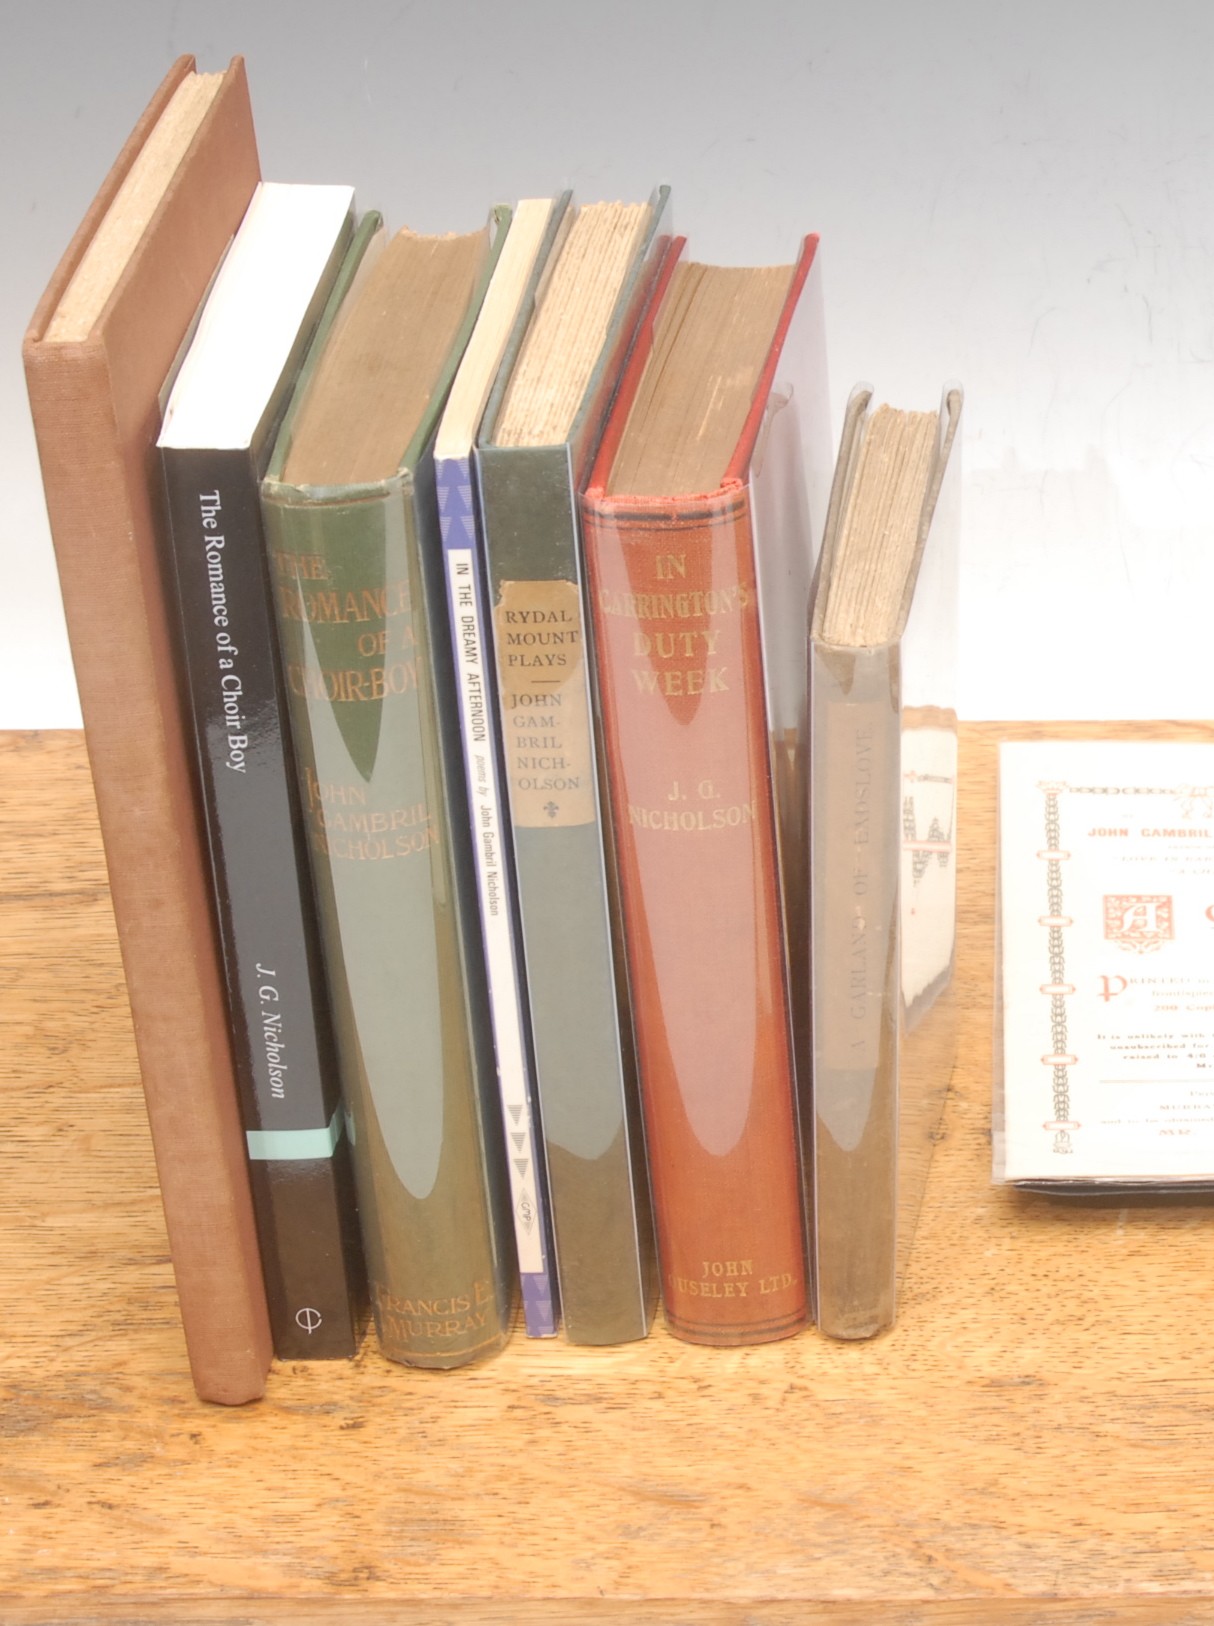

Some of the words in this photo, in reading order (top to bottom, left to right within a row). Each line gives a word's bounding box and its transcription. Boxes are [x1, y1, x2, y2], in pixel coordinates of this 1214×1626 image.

[199, 490, 222, 529] The
[273, 551, 328, 580] THE
[456, 563, 468, 575] IN
[655, 554, 686, 580] IN
[204, 535, 230, 627] Romance
[279, 580, 411, 624] ROMANCE
[458, 585, 472, 607] THE
[506, 610, 572, 624] RYDAL
[216, 632, 238, 655] of
[357, 631, 389, 657] OF
[461, 615, 478, 665] DREAMY
[507, 630, 578, 645] MOUNT
[633, 630, 721, 659] DUTY
[219, 657, 234, 669] a
[508, 654, 567, 666] PLAYS
[631, 667, 730, 696] WEEK
[221, 674, 246, 729] Choir
[467, 673, 486, 742] AFTERNOON
[511, 694, 562, 709] JOHN
[513, 716, 560, 728] GAM-
[226, 734, 248, 774] Boy
[517, 736, 562, 749] BRIL
[475, 755, 487, 784] poems
[517, 757, 571, 769] NICH-
[305, 767, 366, 812] JOHN
[478, 785, 487, 798] by
[518, 777, 580, 791] OLSON
[668, 781, 687, 801] J.
[698, 780, 721, 799] G.
[317, 803, 432, 834] GAMBRIL
[480, 805, 491, 828] John
[629, 800, 756, 831] NICHOLSON
[1088, 828, 1129, 838] JOHN
[482, 831, 497, 867] Gambril
[484, 870, 499, 916] Nicholson
[256, 963, 276, 978] J.
[258, 985, 279, 1005] G.
[261, 1011, 288, 1099] Nicholson
[701, 1260, 753, 1278] JOHN
